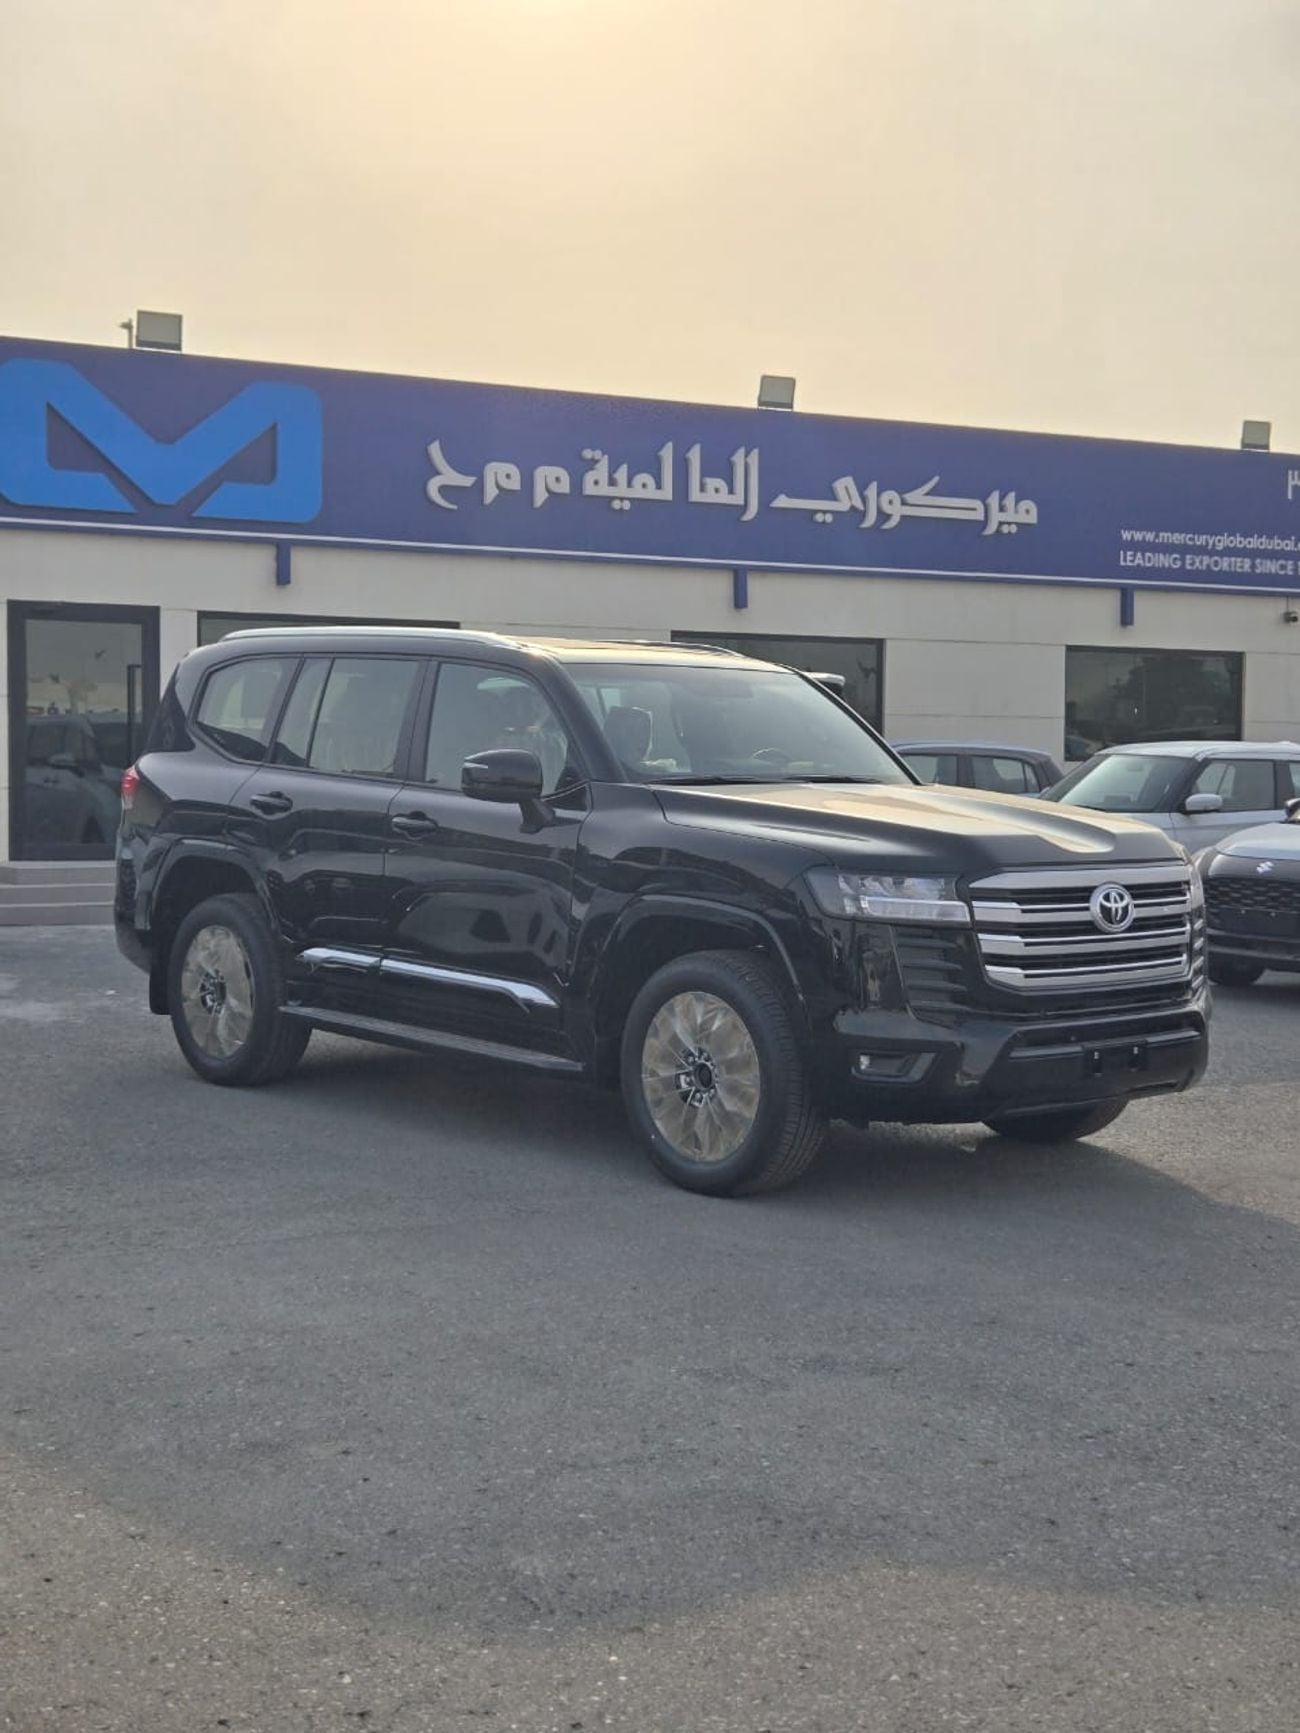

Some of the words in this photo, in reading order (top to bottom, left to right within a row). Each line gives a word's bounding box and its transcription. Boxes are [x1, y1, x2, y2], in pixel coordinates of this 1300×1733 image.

[769, 475, 1038, 536] ميركوري
[1119, 550, 1182, 569] LEADING
[1185, 554, 1252, 573] EXPORTER
[1255, 558, 1294, 576] SINCE
